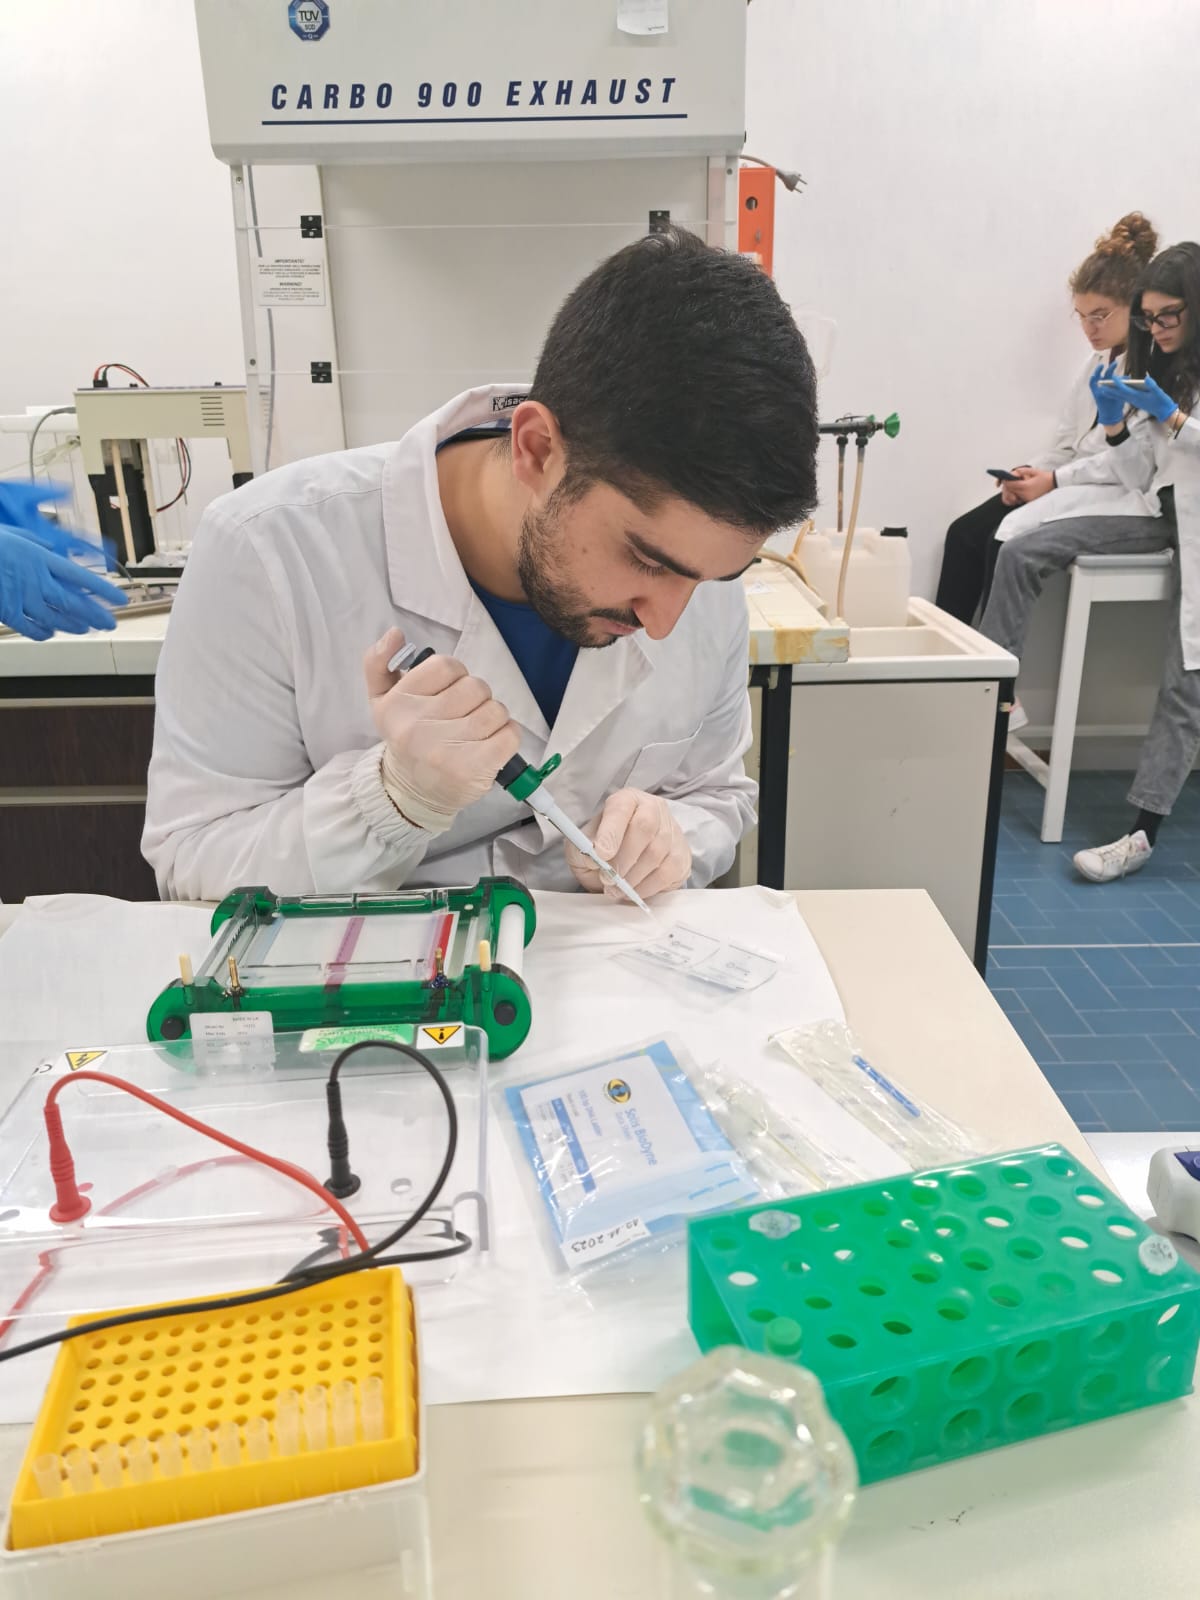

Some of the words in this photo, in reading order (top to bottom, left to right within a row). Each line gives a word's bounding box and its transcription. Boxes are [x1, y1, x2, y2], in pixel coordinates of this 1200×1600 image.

[271, 83, 393, 110] CARBO
[417, 82, 483, 108] 900
[506, 78, 676, 106] EXHAUST
[634, 1128, 658, 1166] BioDyne
